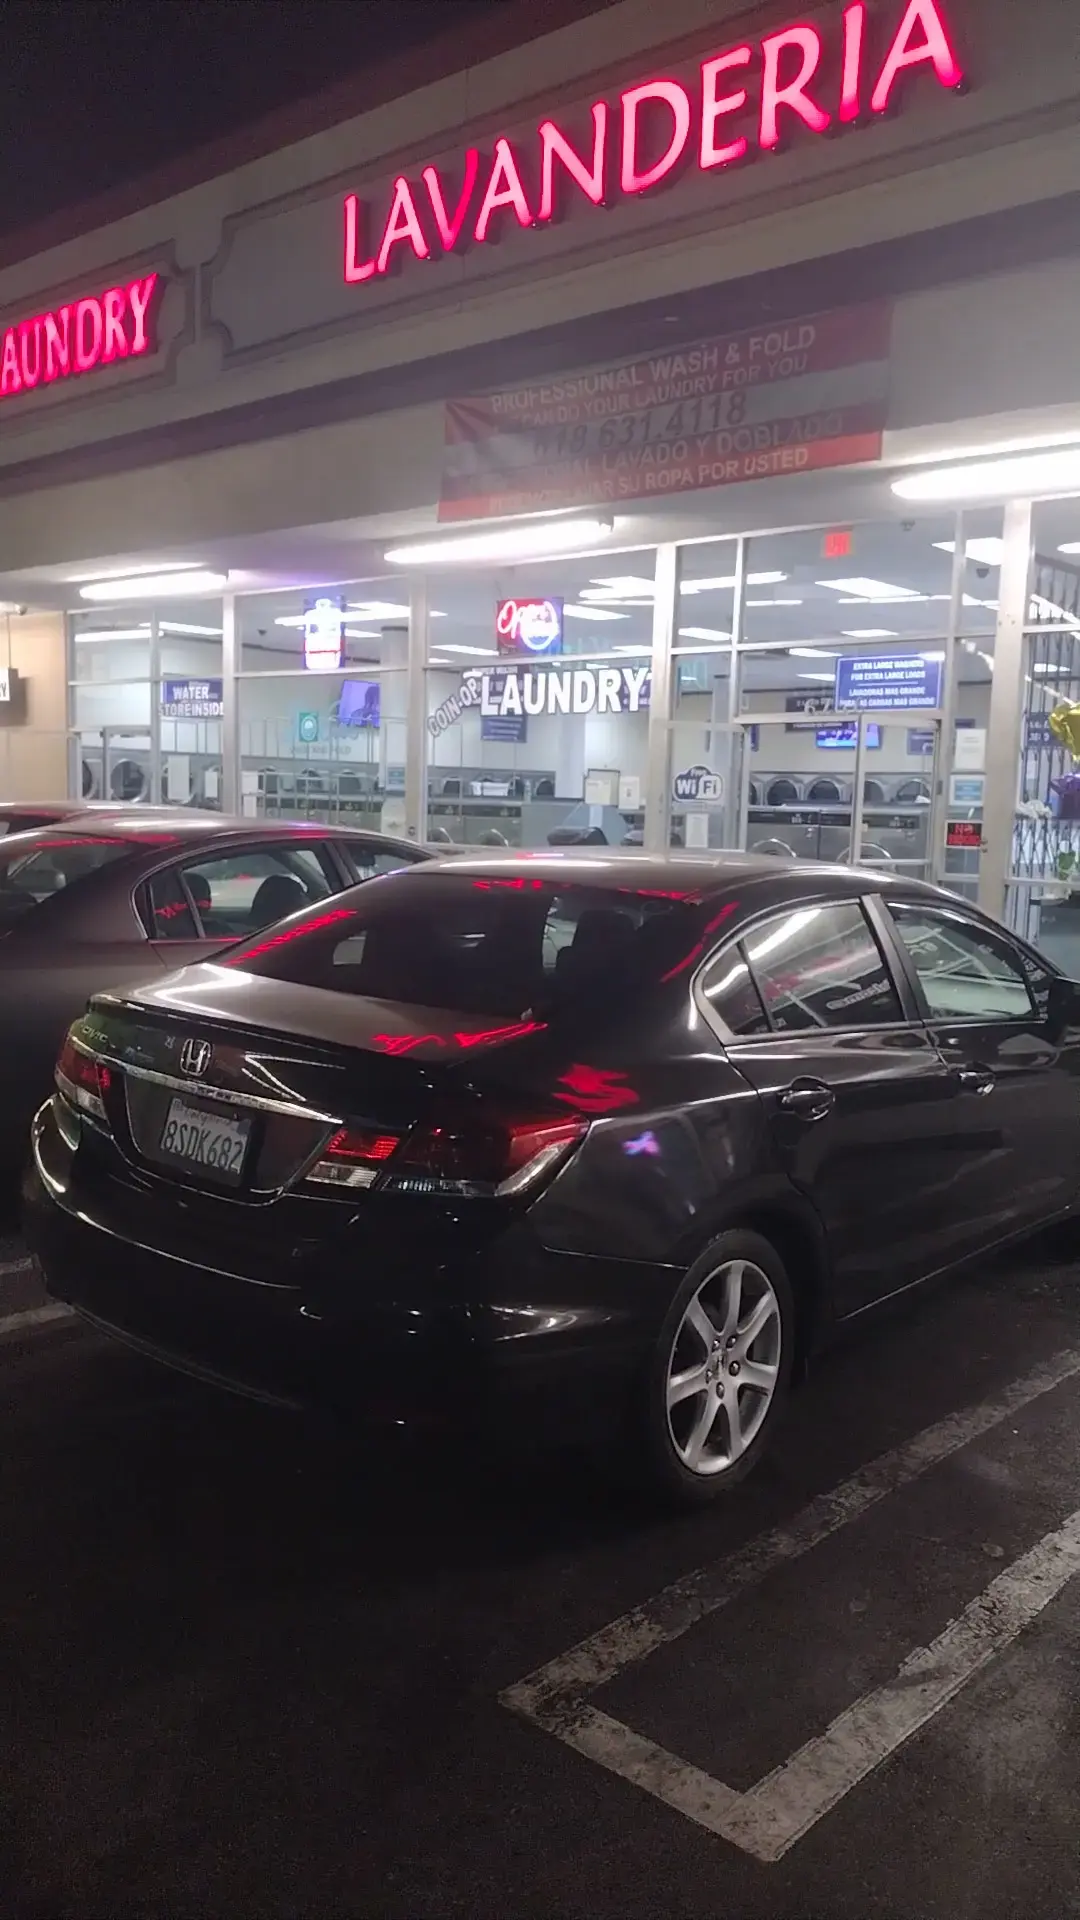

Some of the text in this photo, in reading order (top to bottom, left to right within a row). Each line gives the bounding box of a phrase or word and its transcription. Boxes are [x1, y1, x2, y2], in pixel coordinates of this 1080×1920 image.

[343, 0, 964, 284] LAVANDERIA
[490, 324, 816, 414] PROFESSIONAL WASH & FOLD
[582, 389, 631, 419] YOUR
[635, 374, 718, 408] LAUNDRY
[722, 364, 760, 388] FOR
[766, 354, 808, 382] YOU
[602, 440, 689, 476] LAVADO
[696, 434, 713, 460] Y
[645, 463, 694, 490] ROPA
[698, 460, 739, 486] POR
[744, 447, 809, 477] USTED
[158, 703, 191, 717] STORE
[172, 686, 210, 700] WATER
[427, 675, 480, 738] COIN-OP
[480, 666, 649, 717] LAUNDRY
[161, 1115, 244, 1173] 8SDK682
